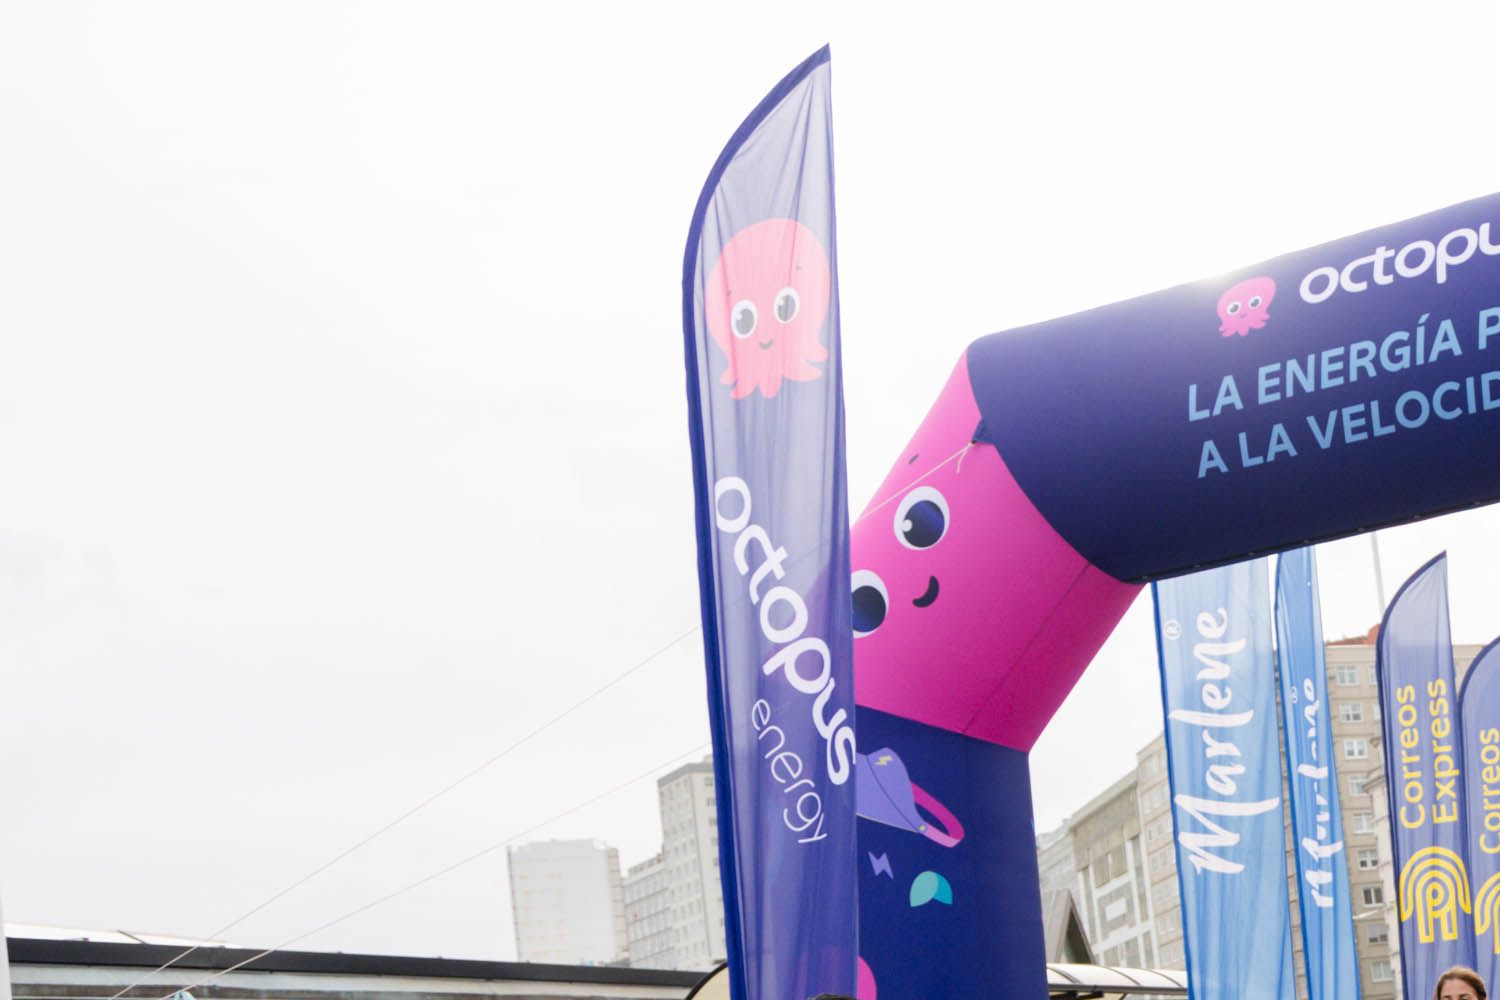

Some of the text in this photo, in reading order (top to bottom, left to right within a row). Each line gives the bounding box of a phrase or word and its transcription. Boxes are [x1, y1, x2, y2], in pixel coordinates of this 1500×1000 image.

[1187, 375, 1244, 422] LA
[1257, 313, 1463, 402] ENERGÍA
[1198, 440, 1229, 478] A
[1238, 422, 1299, 467] LA
[714, 476, 856, 786] octopus
[751, 699, 828, 844] energy
[1168, 606, 1281, 875] Marlene
[1397, 684, 1425, 829] Correos
[1427, 677, 1460, 825] Express
